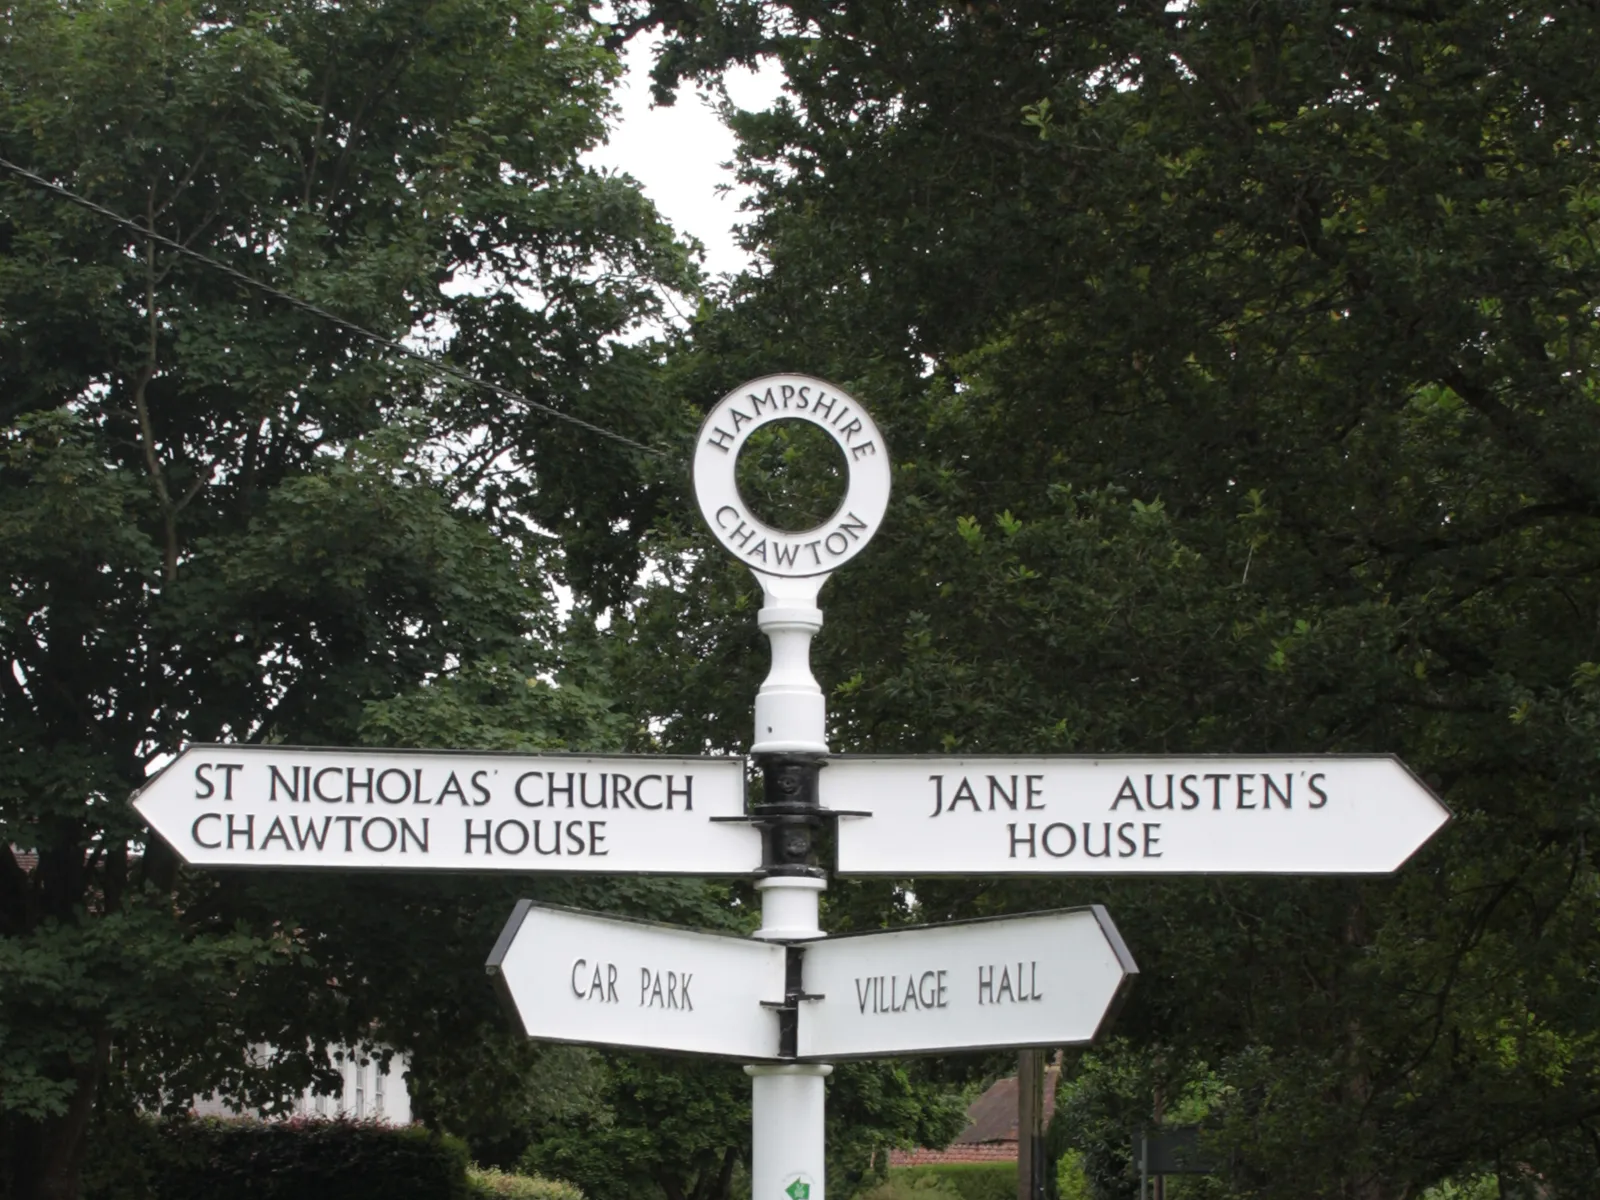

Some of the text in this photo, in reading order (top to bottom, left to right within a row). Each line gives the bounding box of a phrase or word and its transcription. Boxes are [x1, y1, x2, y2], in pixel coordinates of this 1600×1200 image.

[707, 385, 876, 462] HAMPSHIRE
[715, 505, 868, 568] CHAWTON
[194, 763, 244, 801] ST
[514, 771, 694, 811] CHURCH
[928, 771, 1328, 818] JANE AUSTEN'S
[191, 812, 609, 856] CHAWTON HOUSE
[1007, 821, 1163, 858] HOUSE
[571, 958, 693, 1011] CAR PARK
[855, 961, 1043, 1014] VILLAGE HALL
